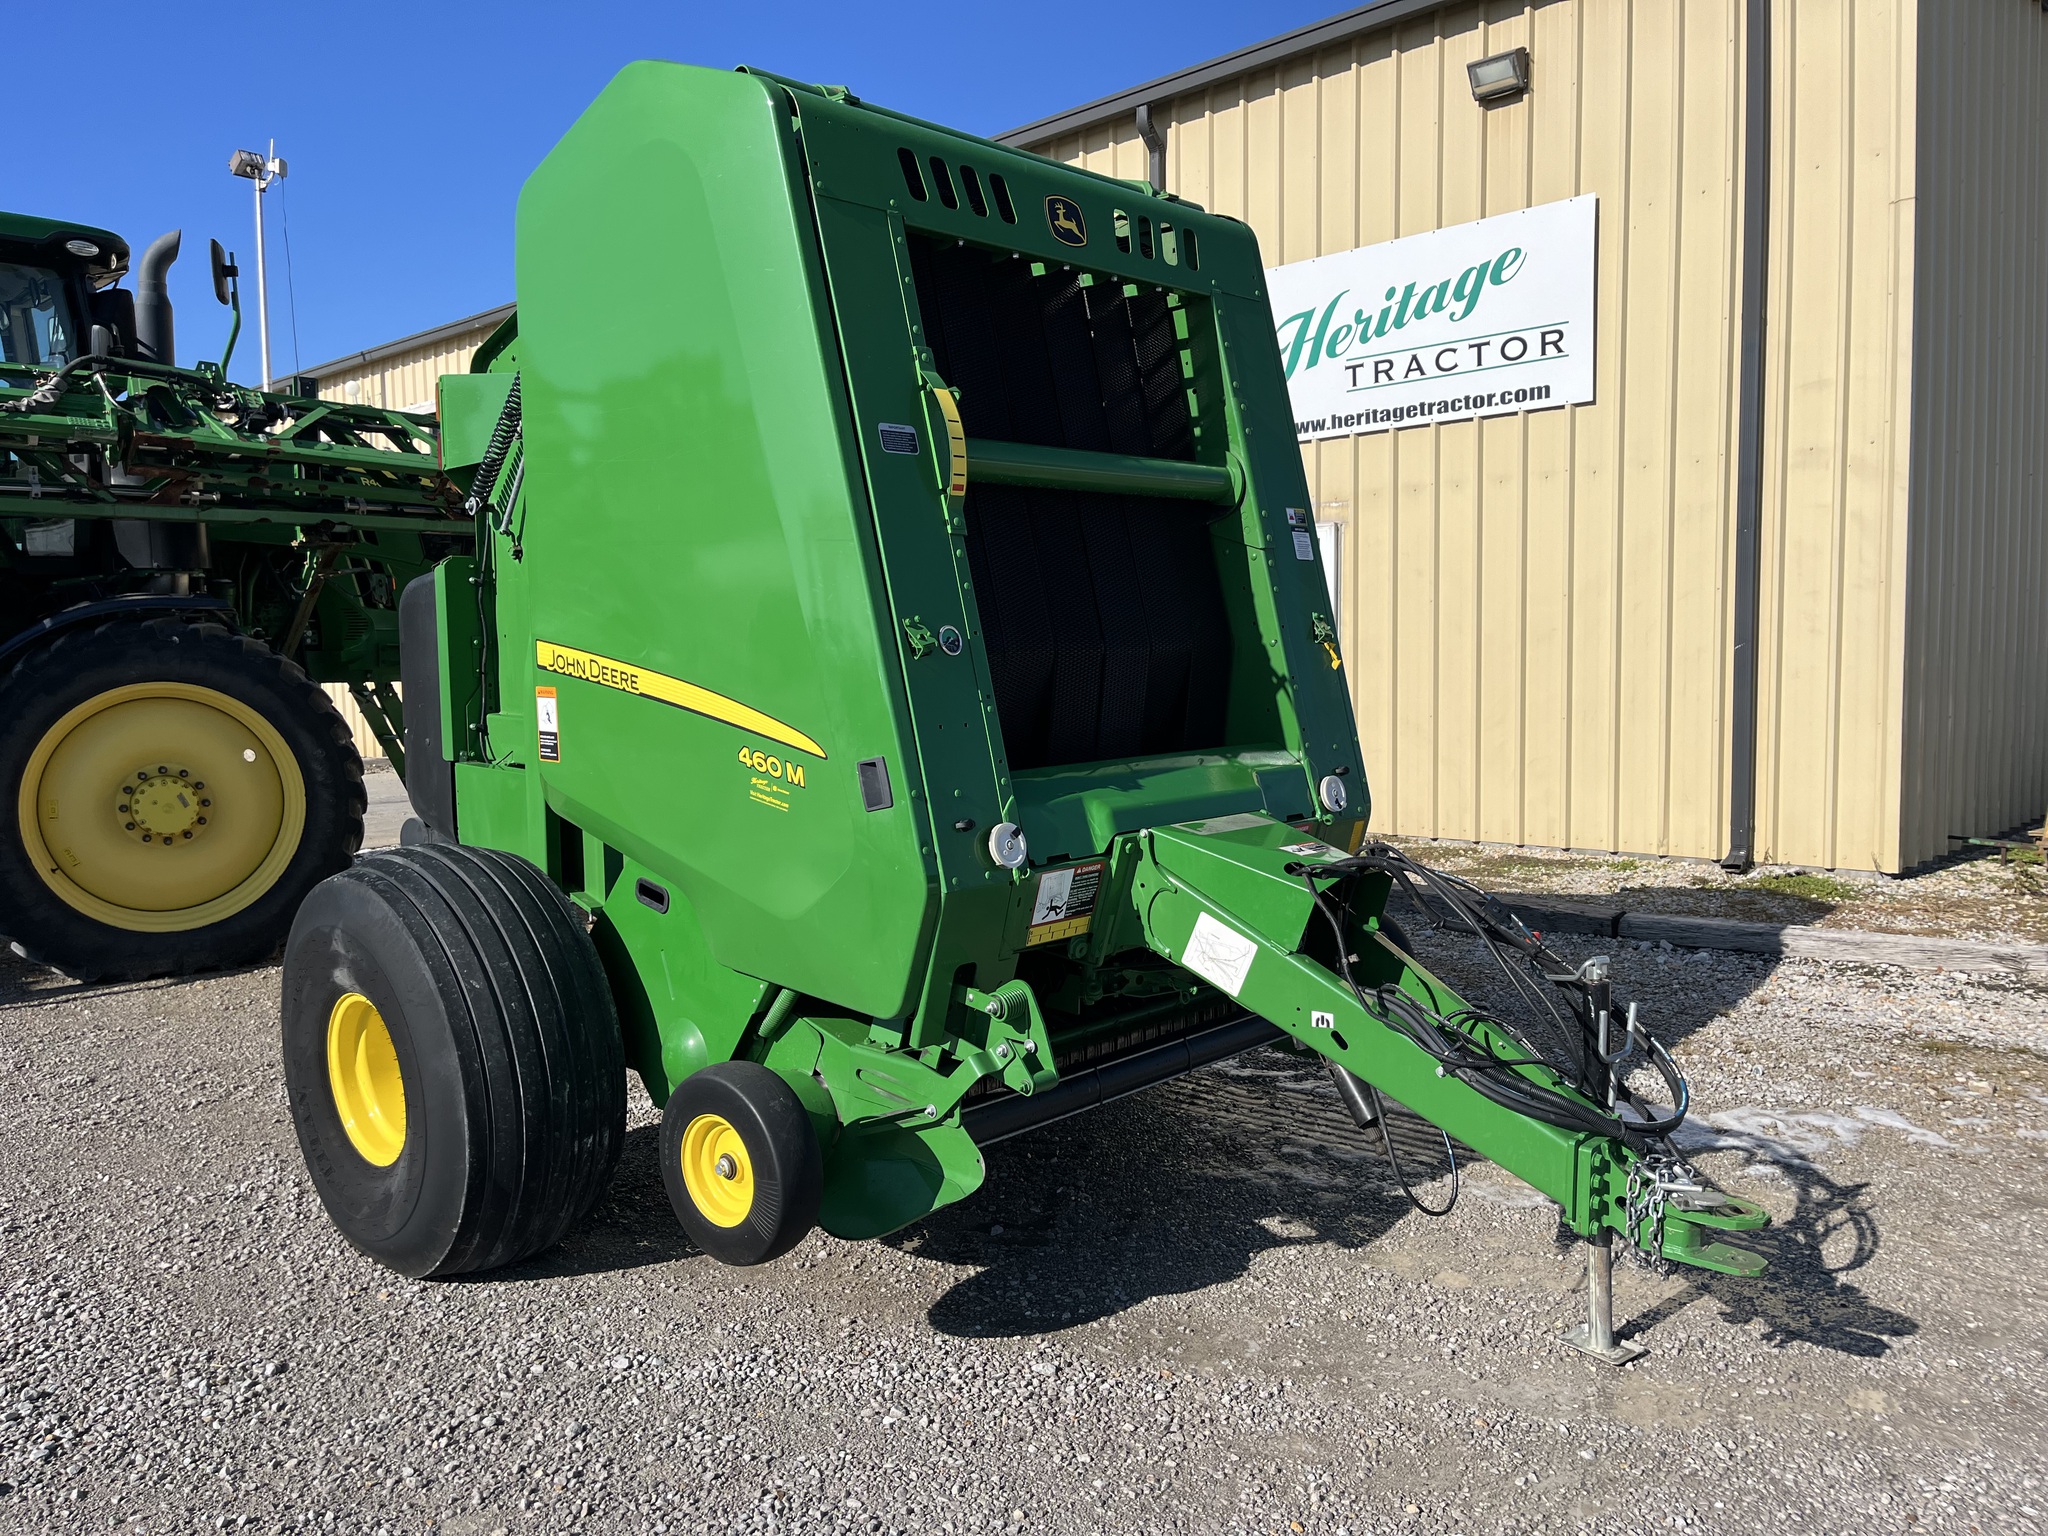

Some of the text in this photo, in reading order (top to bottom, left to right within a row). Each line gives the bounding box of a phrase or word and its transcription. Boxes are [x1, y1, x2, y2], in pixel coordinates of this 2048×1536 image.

[1276, 247, 1527, 382] Heritage
[1344, 328, 1565, 387] TRACTOR
[548, 649, 639, 691] JOHN DEERE
[738, 745, 806, 789] 460 M
